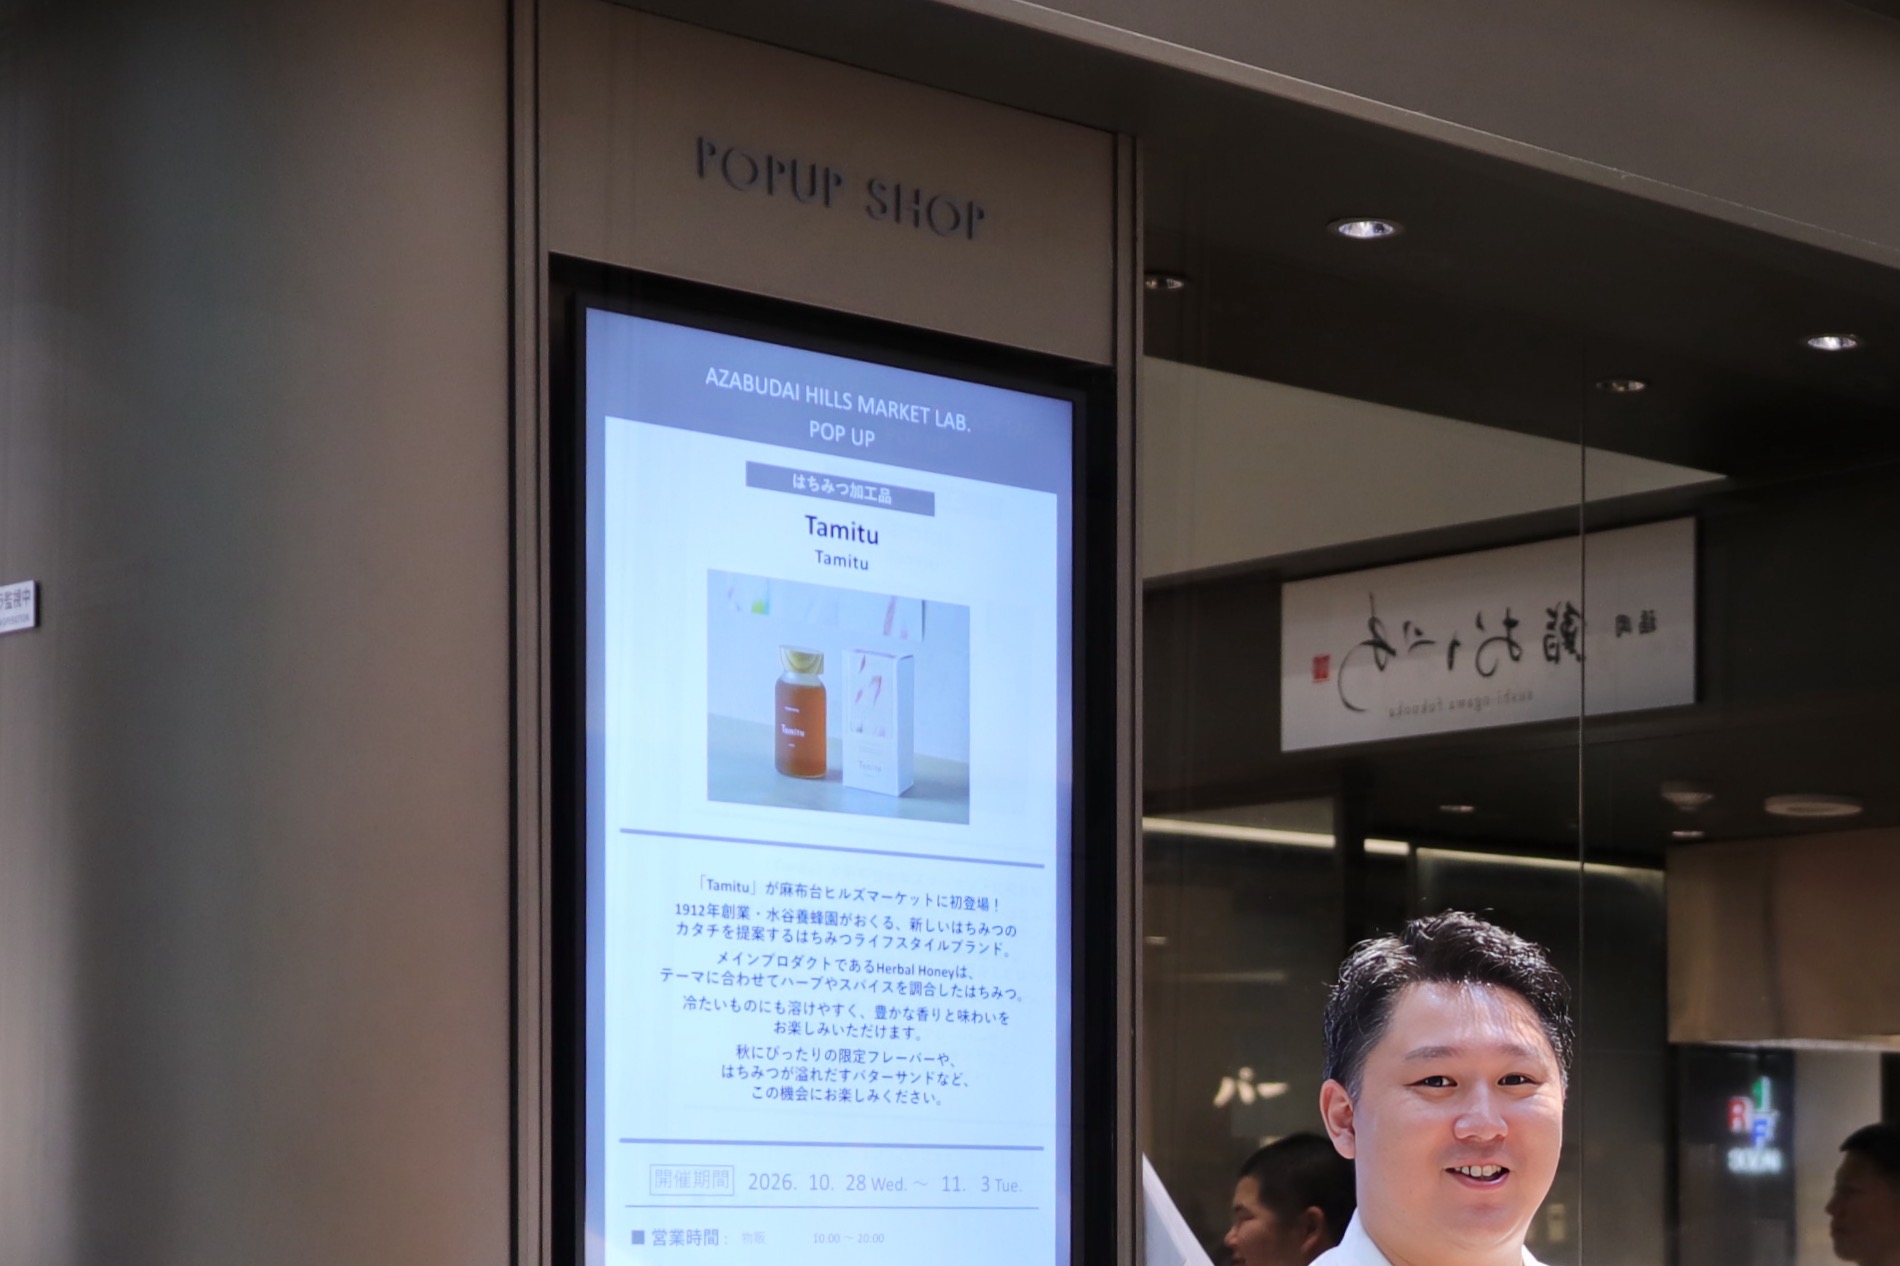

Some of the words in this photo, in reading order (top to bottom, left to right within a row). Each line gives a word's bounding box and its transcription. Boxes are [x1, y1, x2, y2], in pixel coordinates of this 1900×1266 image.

[696, 136, 842, 208] POPUP
[865, 177, 986, 240] SHOP
[705, 367, 800, 401] AZABUDAI
[805, 385, 853, 412] HILLS
[857, 394, 930, 425] MARKET
[935, 410, 972, 433] LAB.
[809, 420, 847, 443] POP
[851, 426, 876, 447] UP
[791, 472, 893, 506] はちみつ加工品
[804, 515, 880, 546] Tamitu
[814, 550, 870, 572] Tamitu
[780, 723, 806, 738] Tamitu
[773, 1020, 921, 1041] お楽しみいただけます。
[752, 1085, 942, 1106] この機会にお楽しみください。
[654, 1169, 730, 1190] 開催期間
[845, 1174, 867, 1192] 28
[871, 1176, 908, 1193] Wed.
[980, 1176, 991, 1193] 3
[995, 1177, 1023, 1194] Tue.
